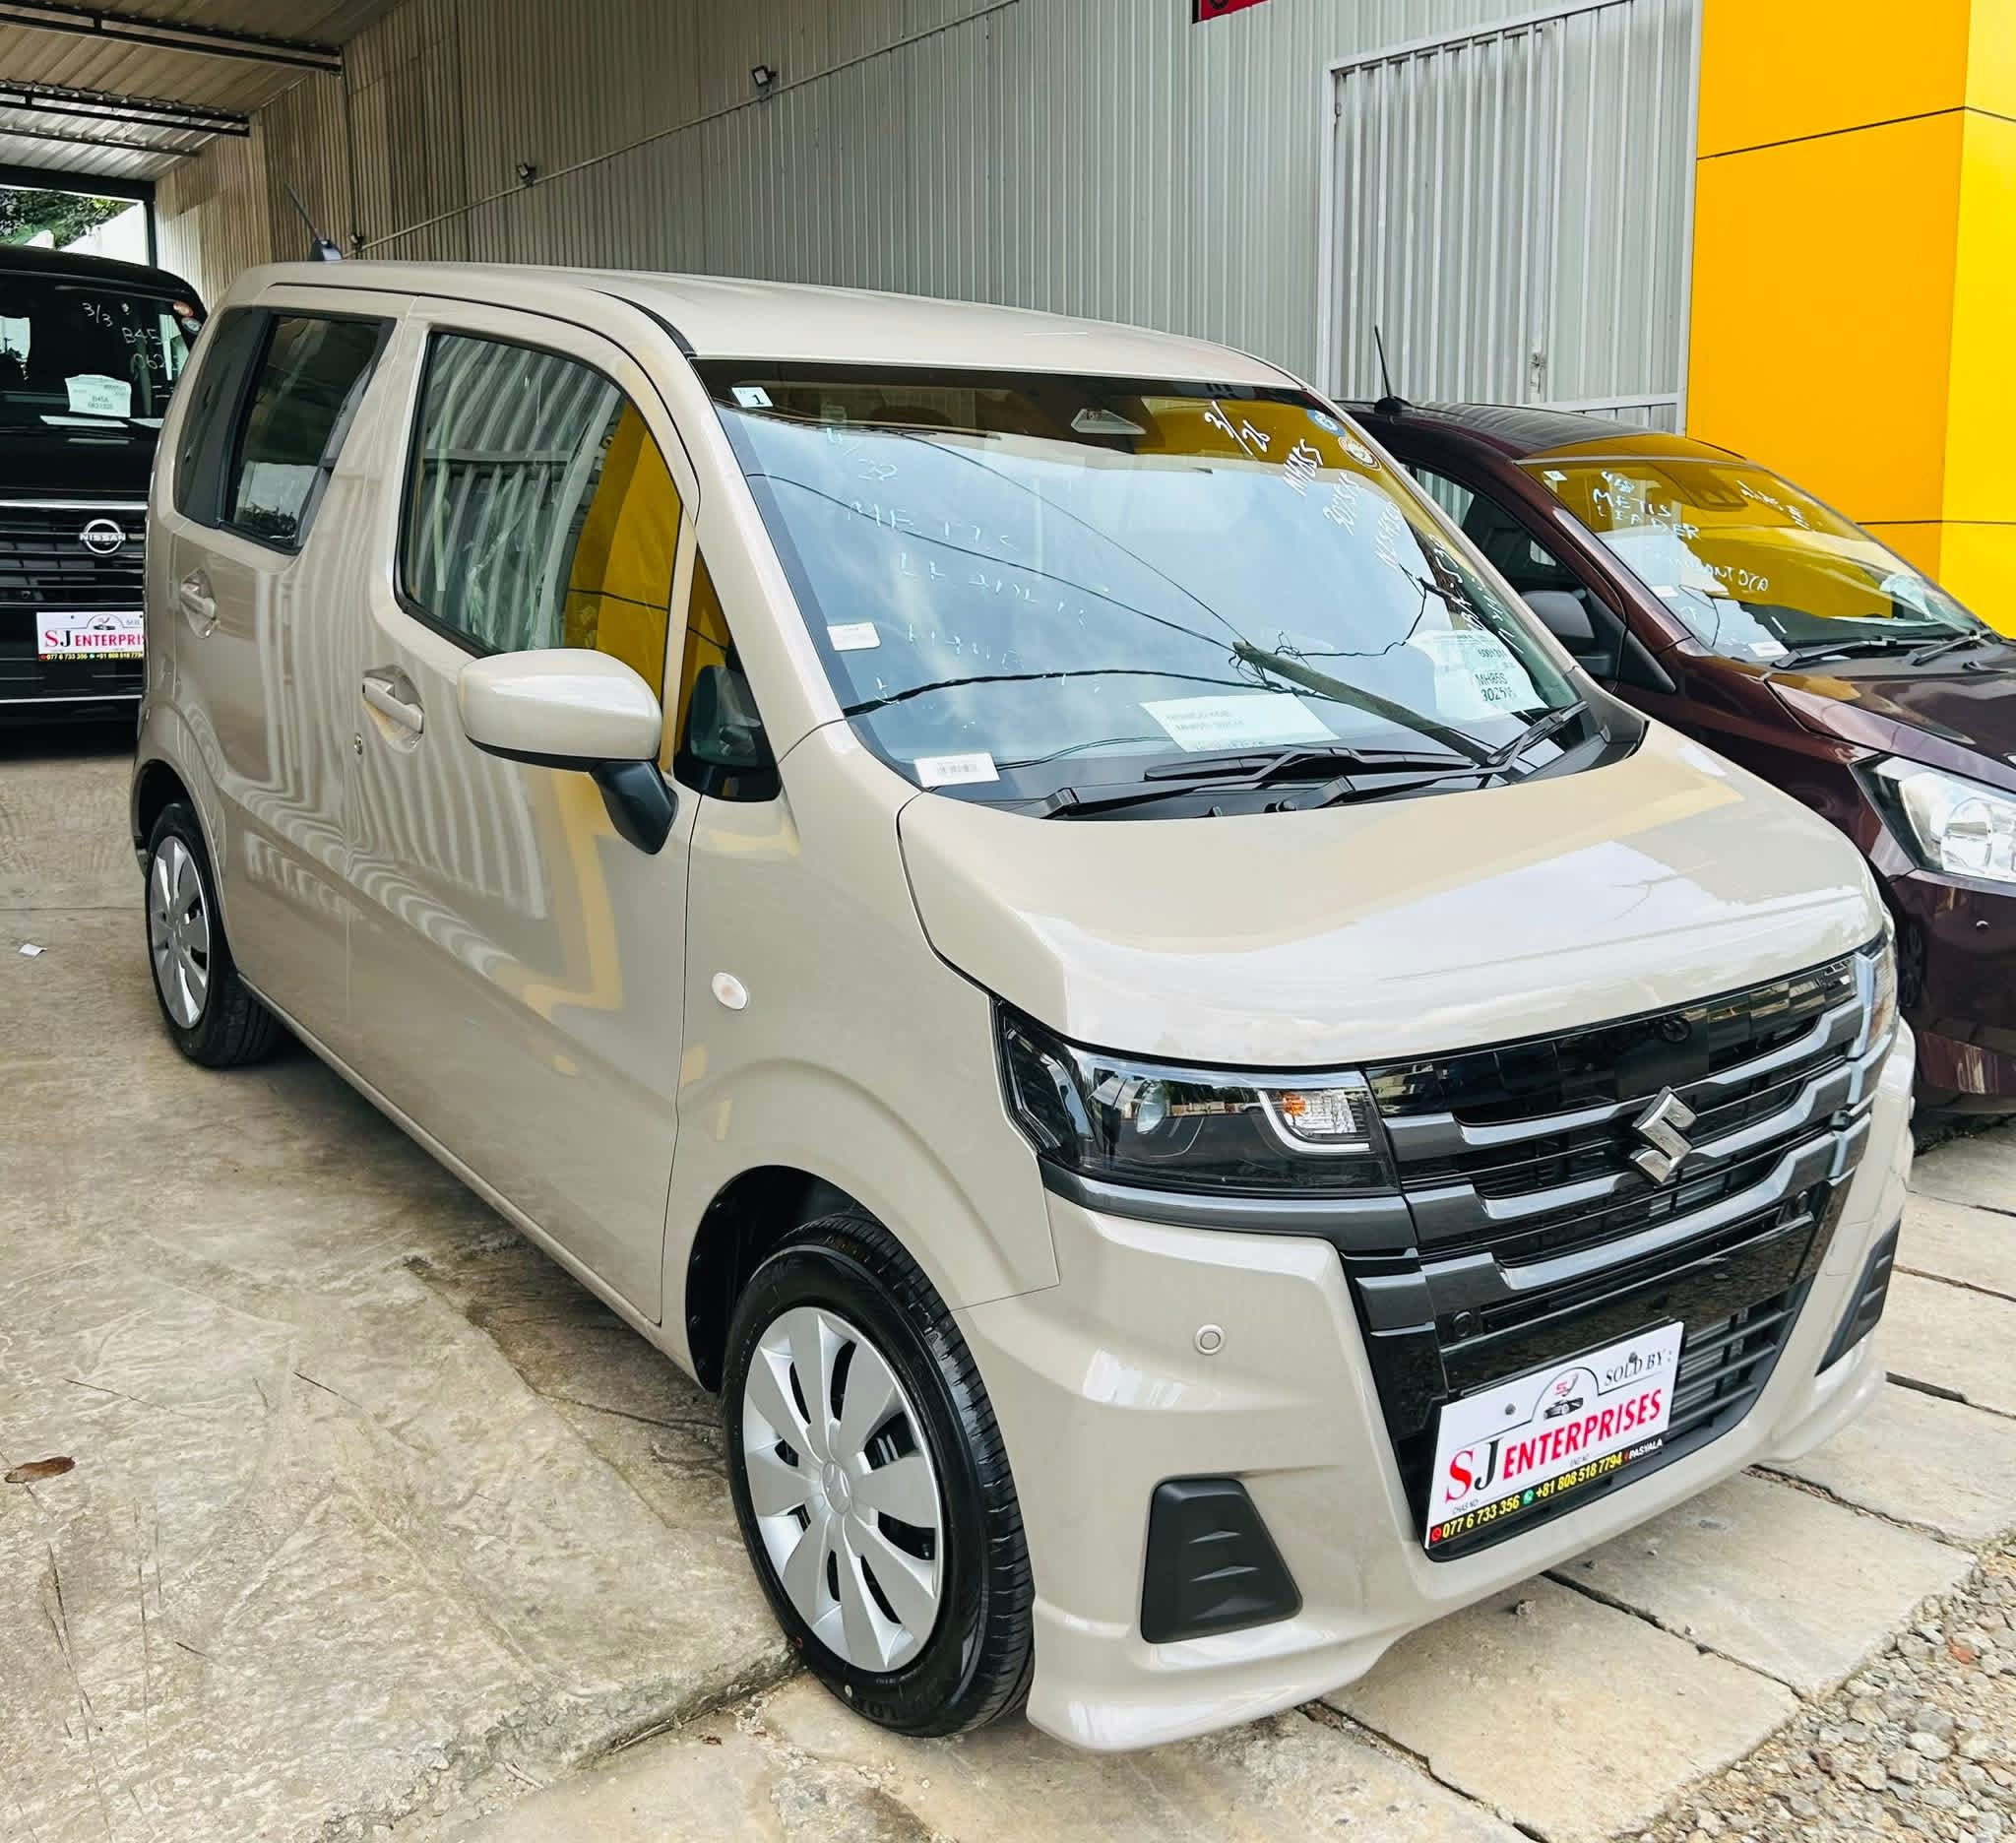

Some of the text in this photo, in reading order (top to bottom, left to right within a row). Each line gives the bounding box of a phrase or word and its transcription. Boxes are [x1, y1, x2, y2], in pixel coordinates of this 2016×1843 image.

[80, 532, 126, 541] NISSAN
[44, 629, 145, 648] SJ ENTERPRI
[1605, 1359, 1643, 1386] SOLD
[1444, 1388, 1662, 1504] SJ ENTERPRISES
[1442, 1517, 1465, 1538] 077
[1466, 1513, 1475, 1529] 6
[1477, 1503, 1497, 1524] 733
[1499, 1494, 1521, 1515] 356
[1536, 1480, 1555, 1497] +81
[1557, 1471, 1577, 1491] 808
[1578, 1462, 1598, 1482] 518
[1599, 1451, 1623, 1474] 7794
